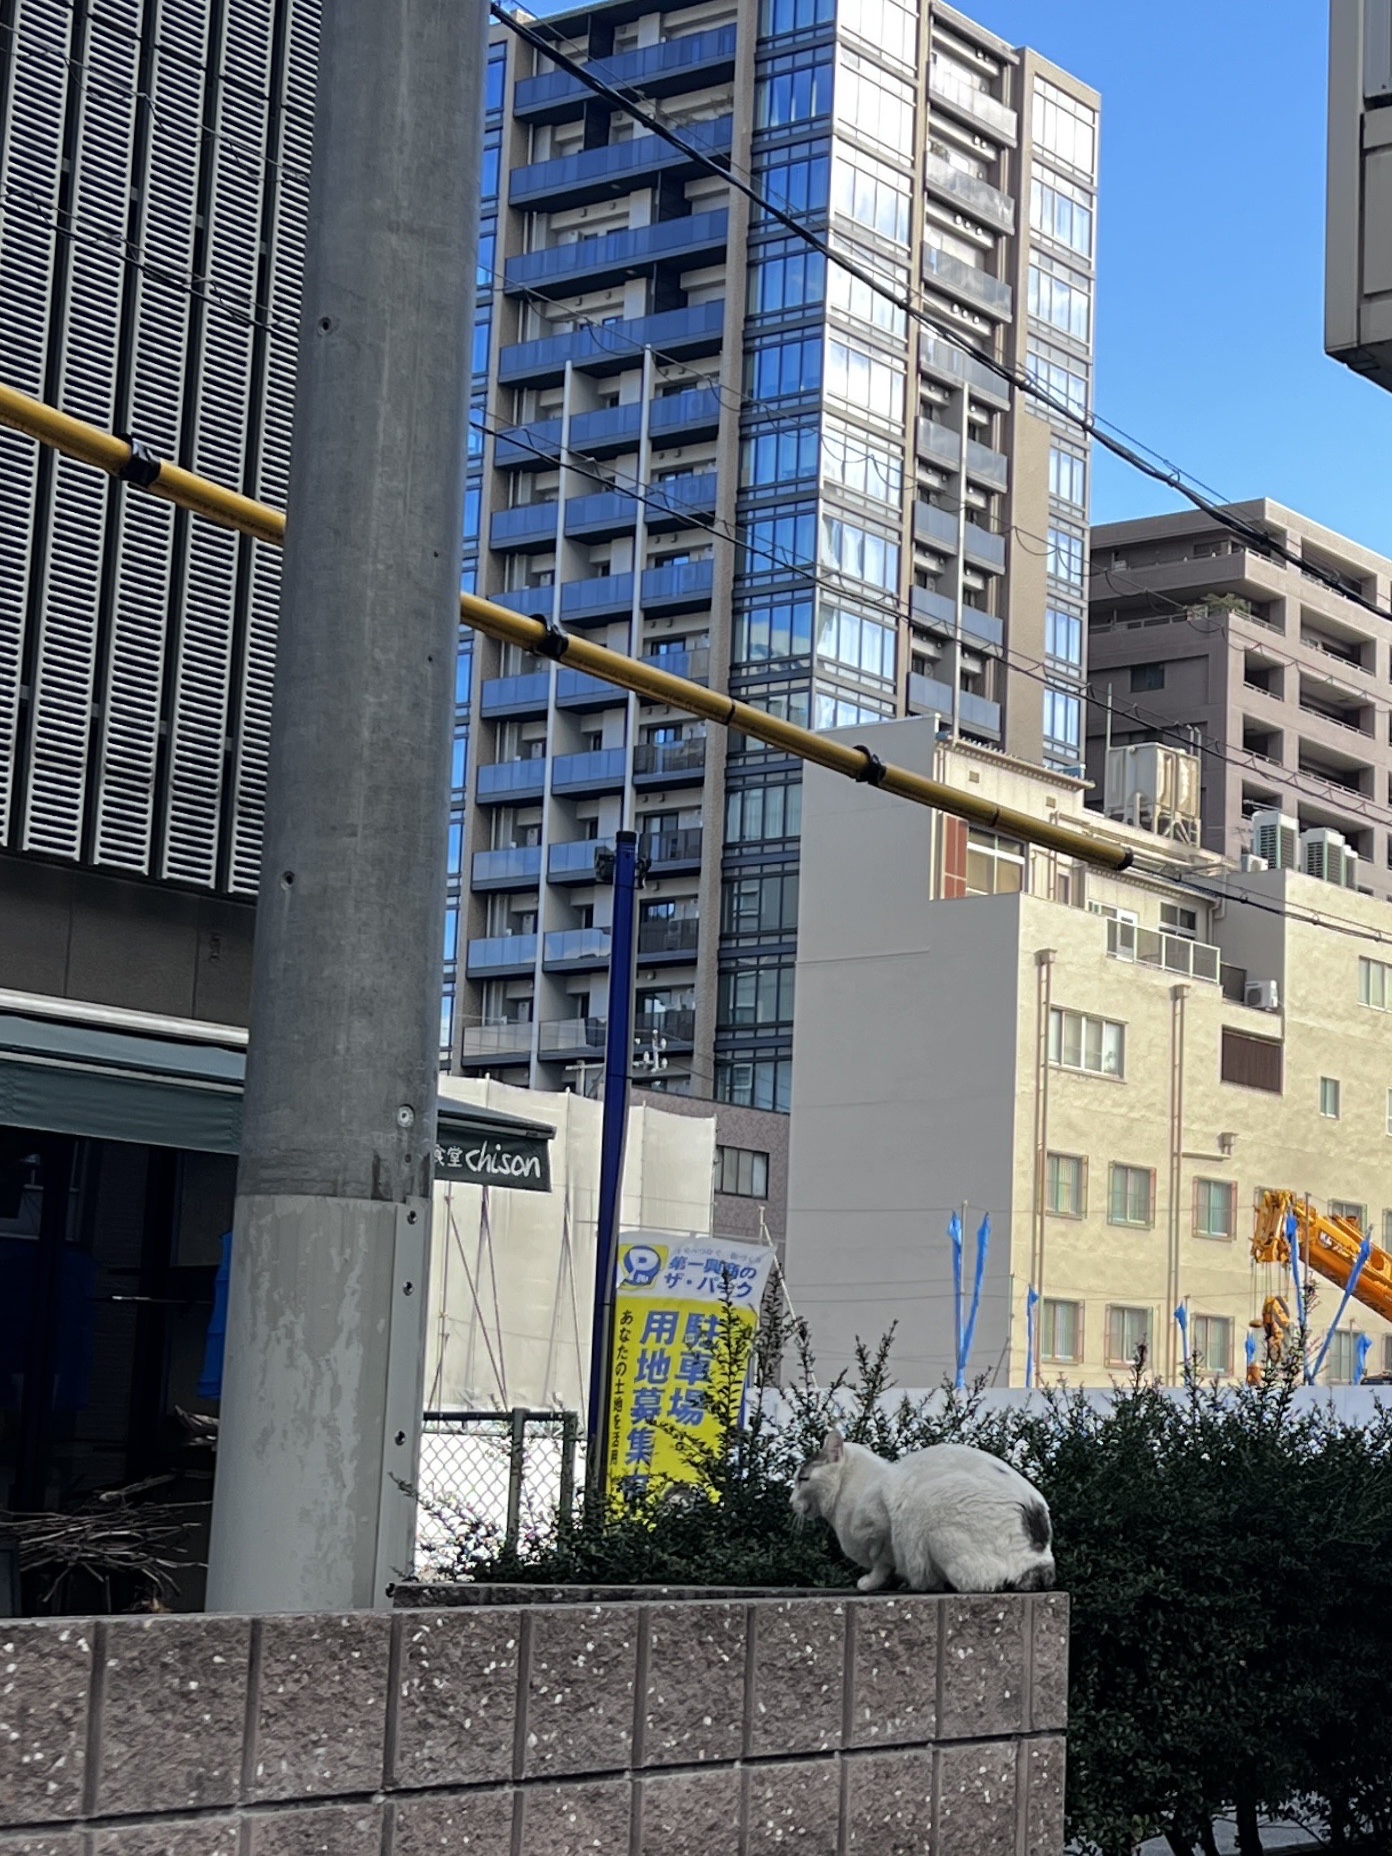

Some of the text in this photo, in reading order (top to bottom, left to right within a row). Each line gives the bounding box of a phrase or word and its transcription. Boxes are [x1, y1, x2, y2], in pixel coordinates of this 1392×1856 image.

[465, 1140, 541, 1178] chison
[667, 1312, 720, 1426] 駐車場
